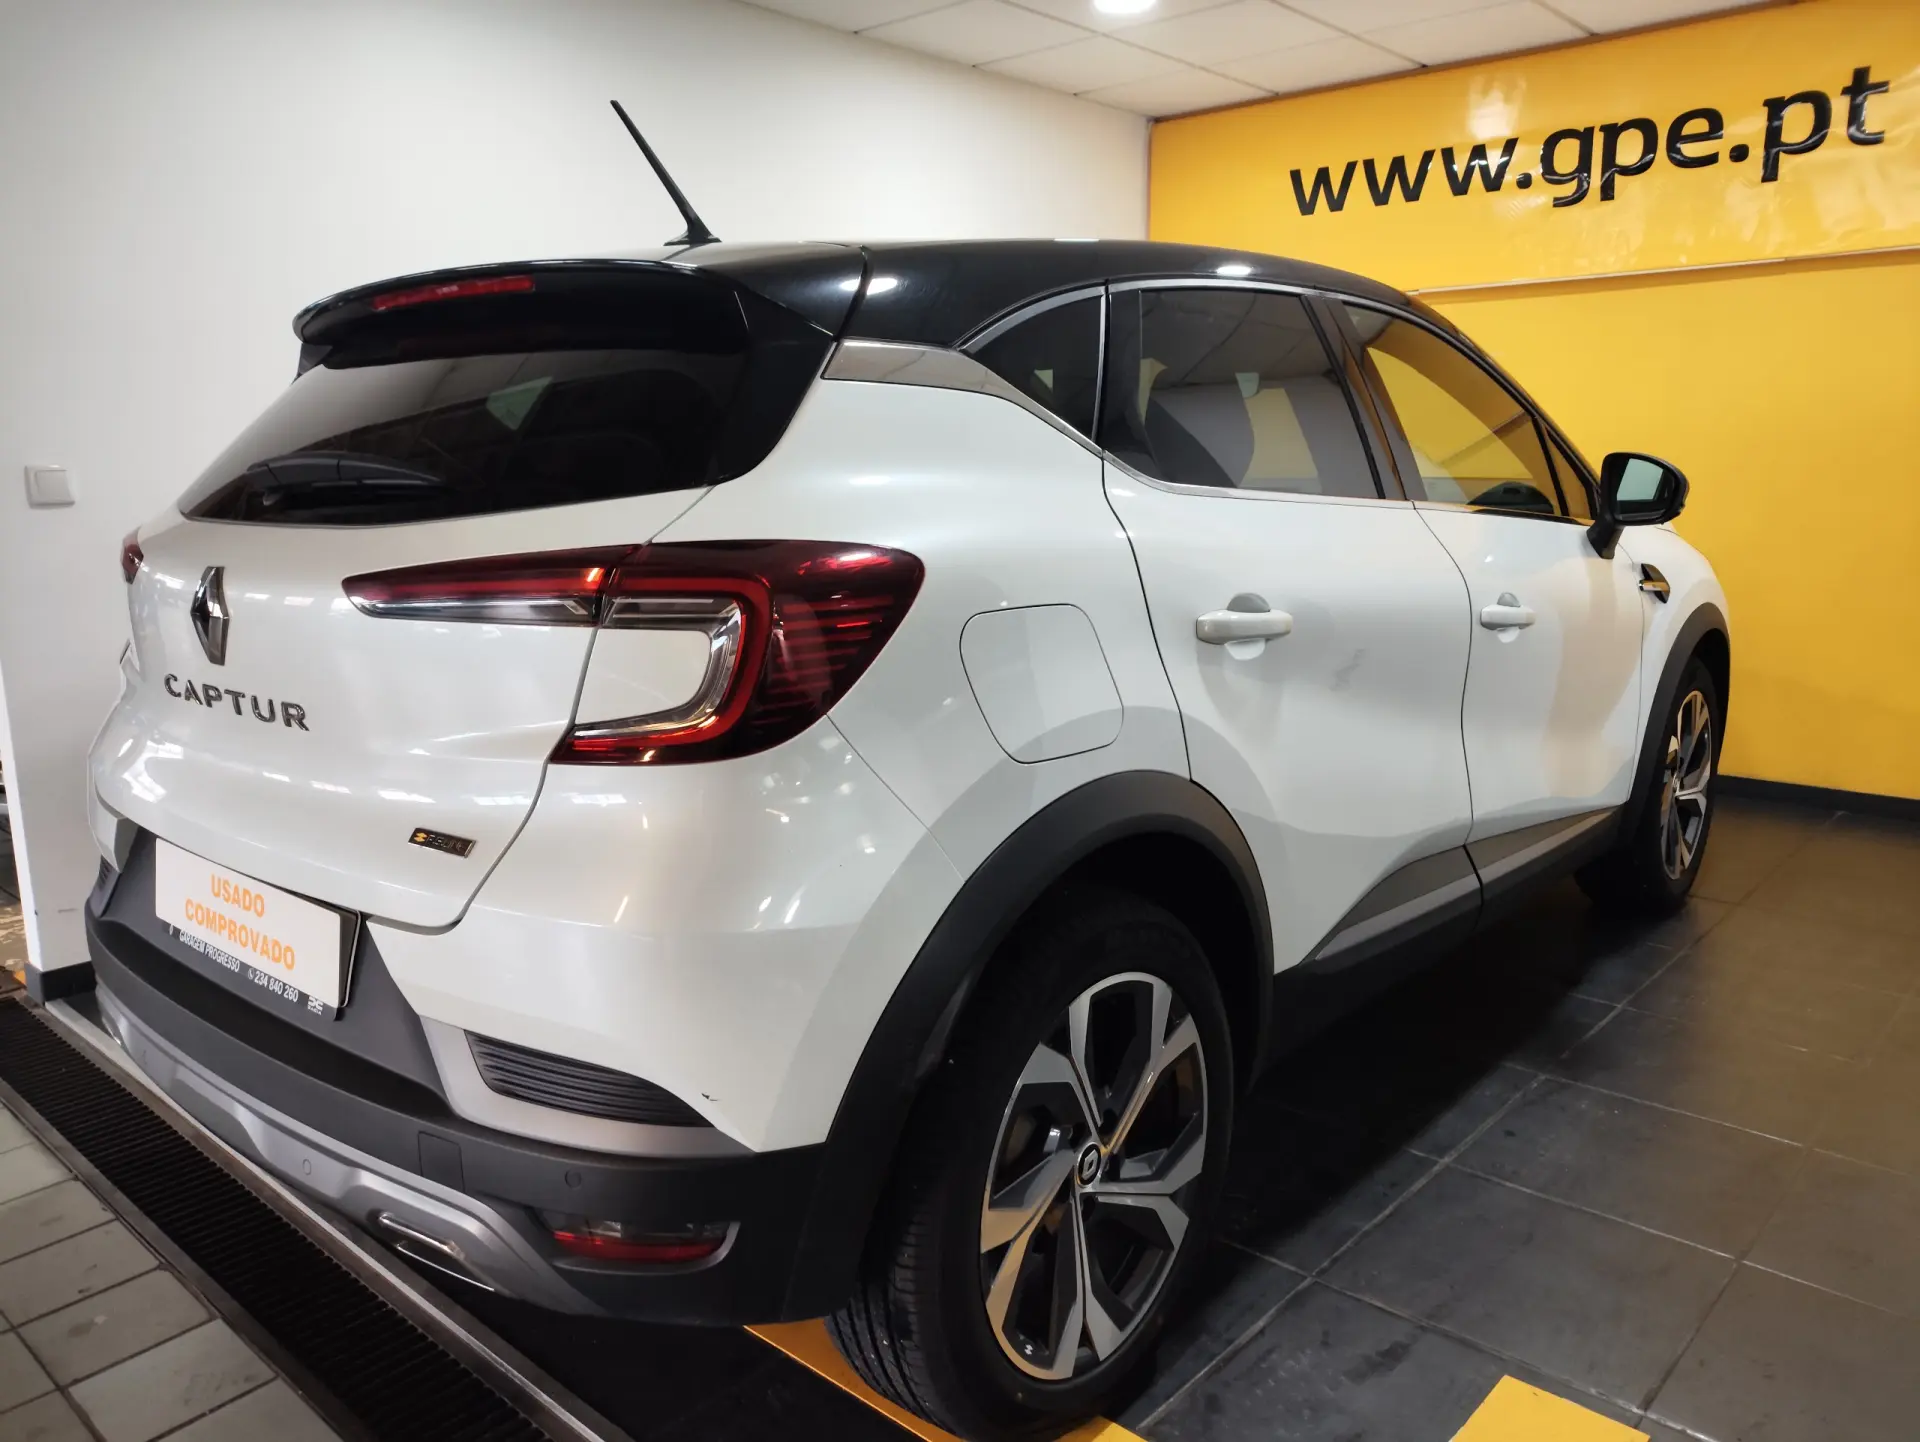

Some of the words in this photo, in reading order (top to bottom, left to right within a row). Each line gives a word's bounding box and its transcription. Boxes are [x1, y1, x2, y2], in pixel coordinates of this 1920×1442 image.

[1289, 65, 1891, 217] www.gpe.pt
[163, 673, 310, 732] CAPTUR
[210, 873, 265, 918] USADO
[179, 928, 206, 954] GARAGEM
[205, 943, 240, 973] PROGRESSO
[254, 970, 269, 988] 234
[269, 978, 284, 995] 840
[283, 985, 299, 1003] 260
[184, 898, 295, 971] COMPROVADO
